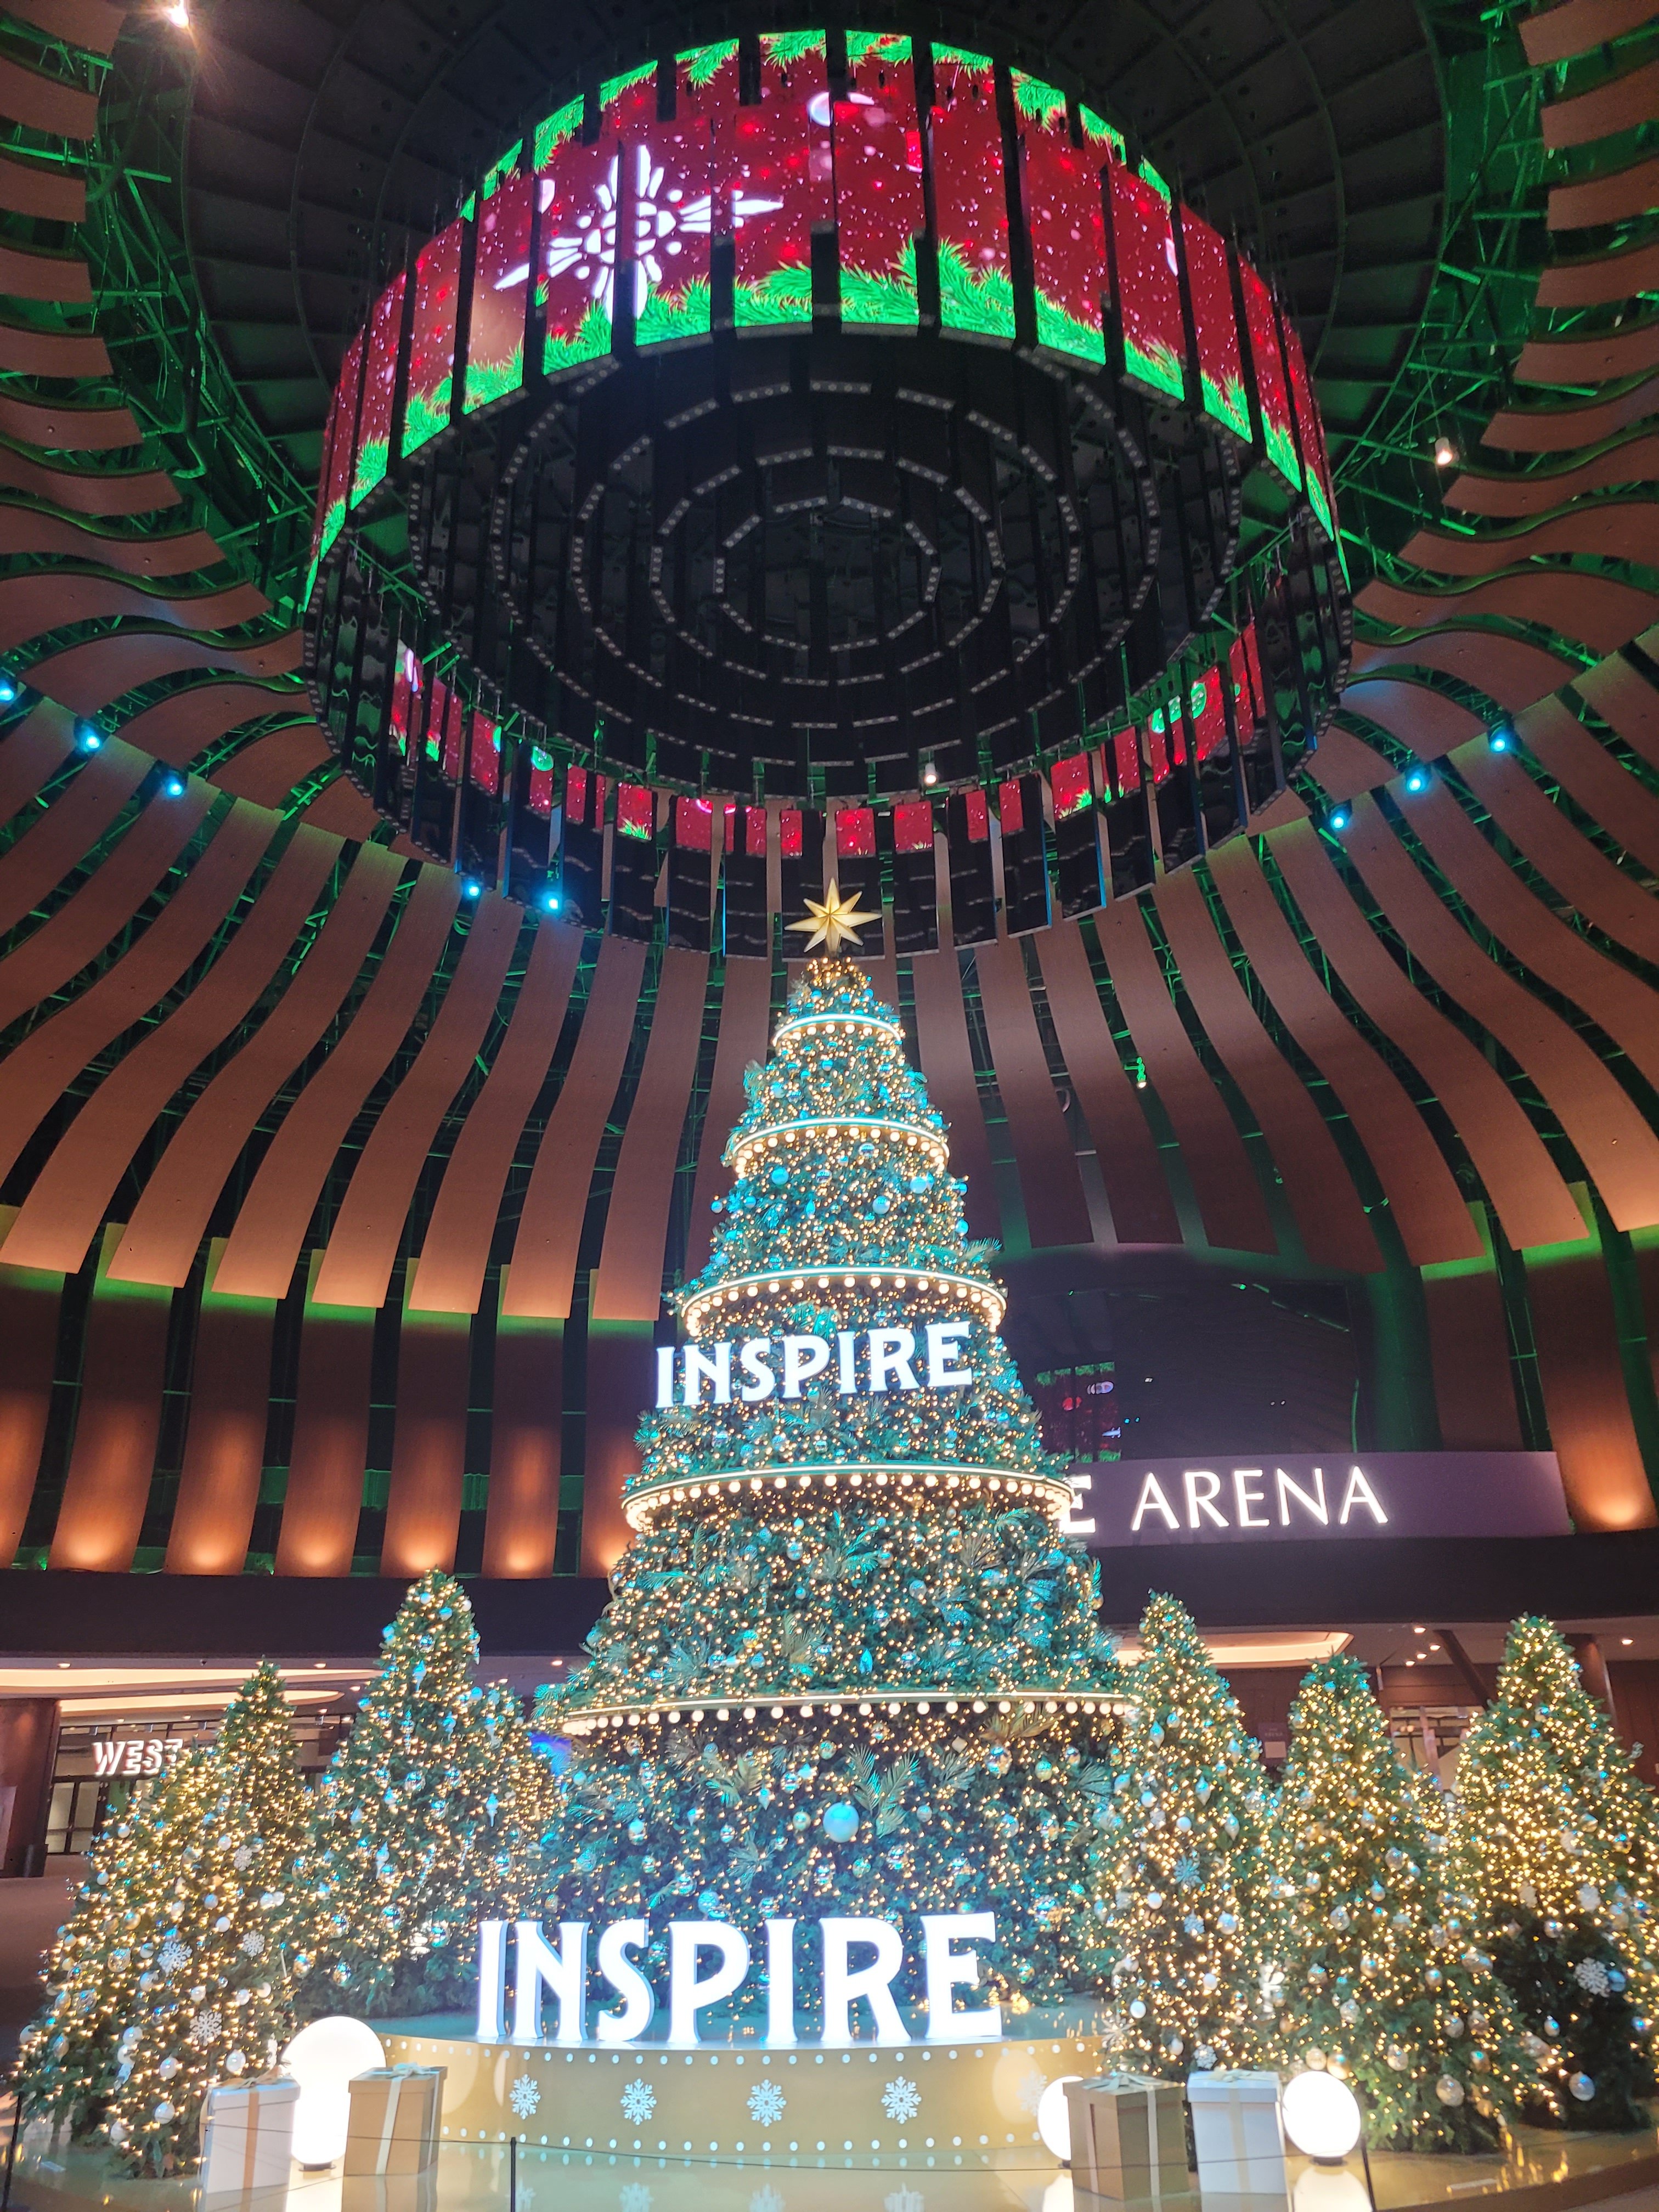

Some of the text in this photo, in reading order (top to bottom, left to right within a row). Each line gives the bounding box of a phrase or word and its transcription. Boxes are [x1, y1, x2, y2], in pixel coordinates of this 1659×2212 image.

[656, 1321, 973, 1408] INSPIRE
[1131, 1465, 1389, 1531] ARENA
[92, 1738, 183, 1776] WEST
[476, 1911, 1003, 2051] INSPIRE
